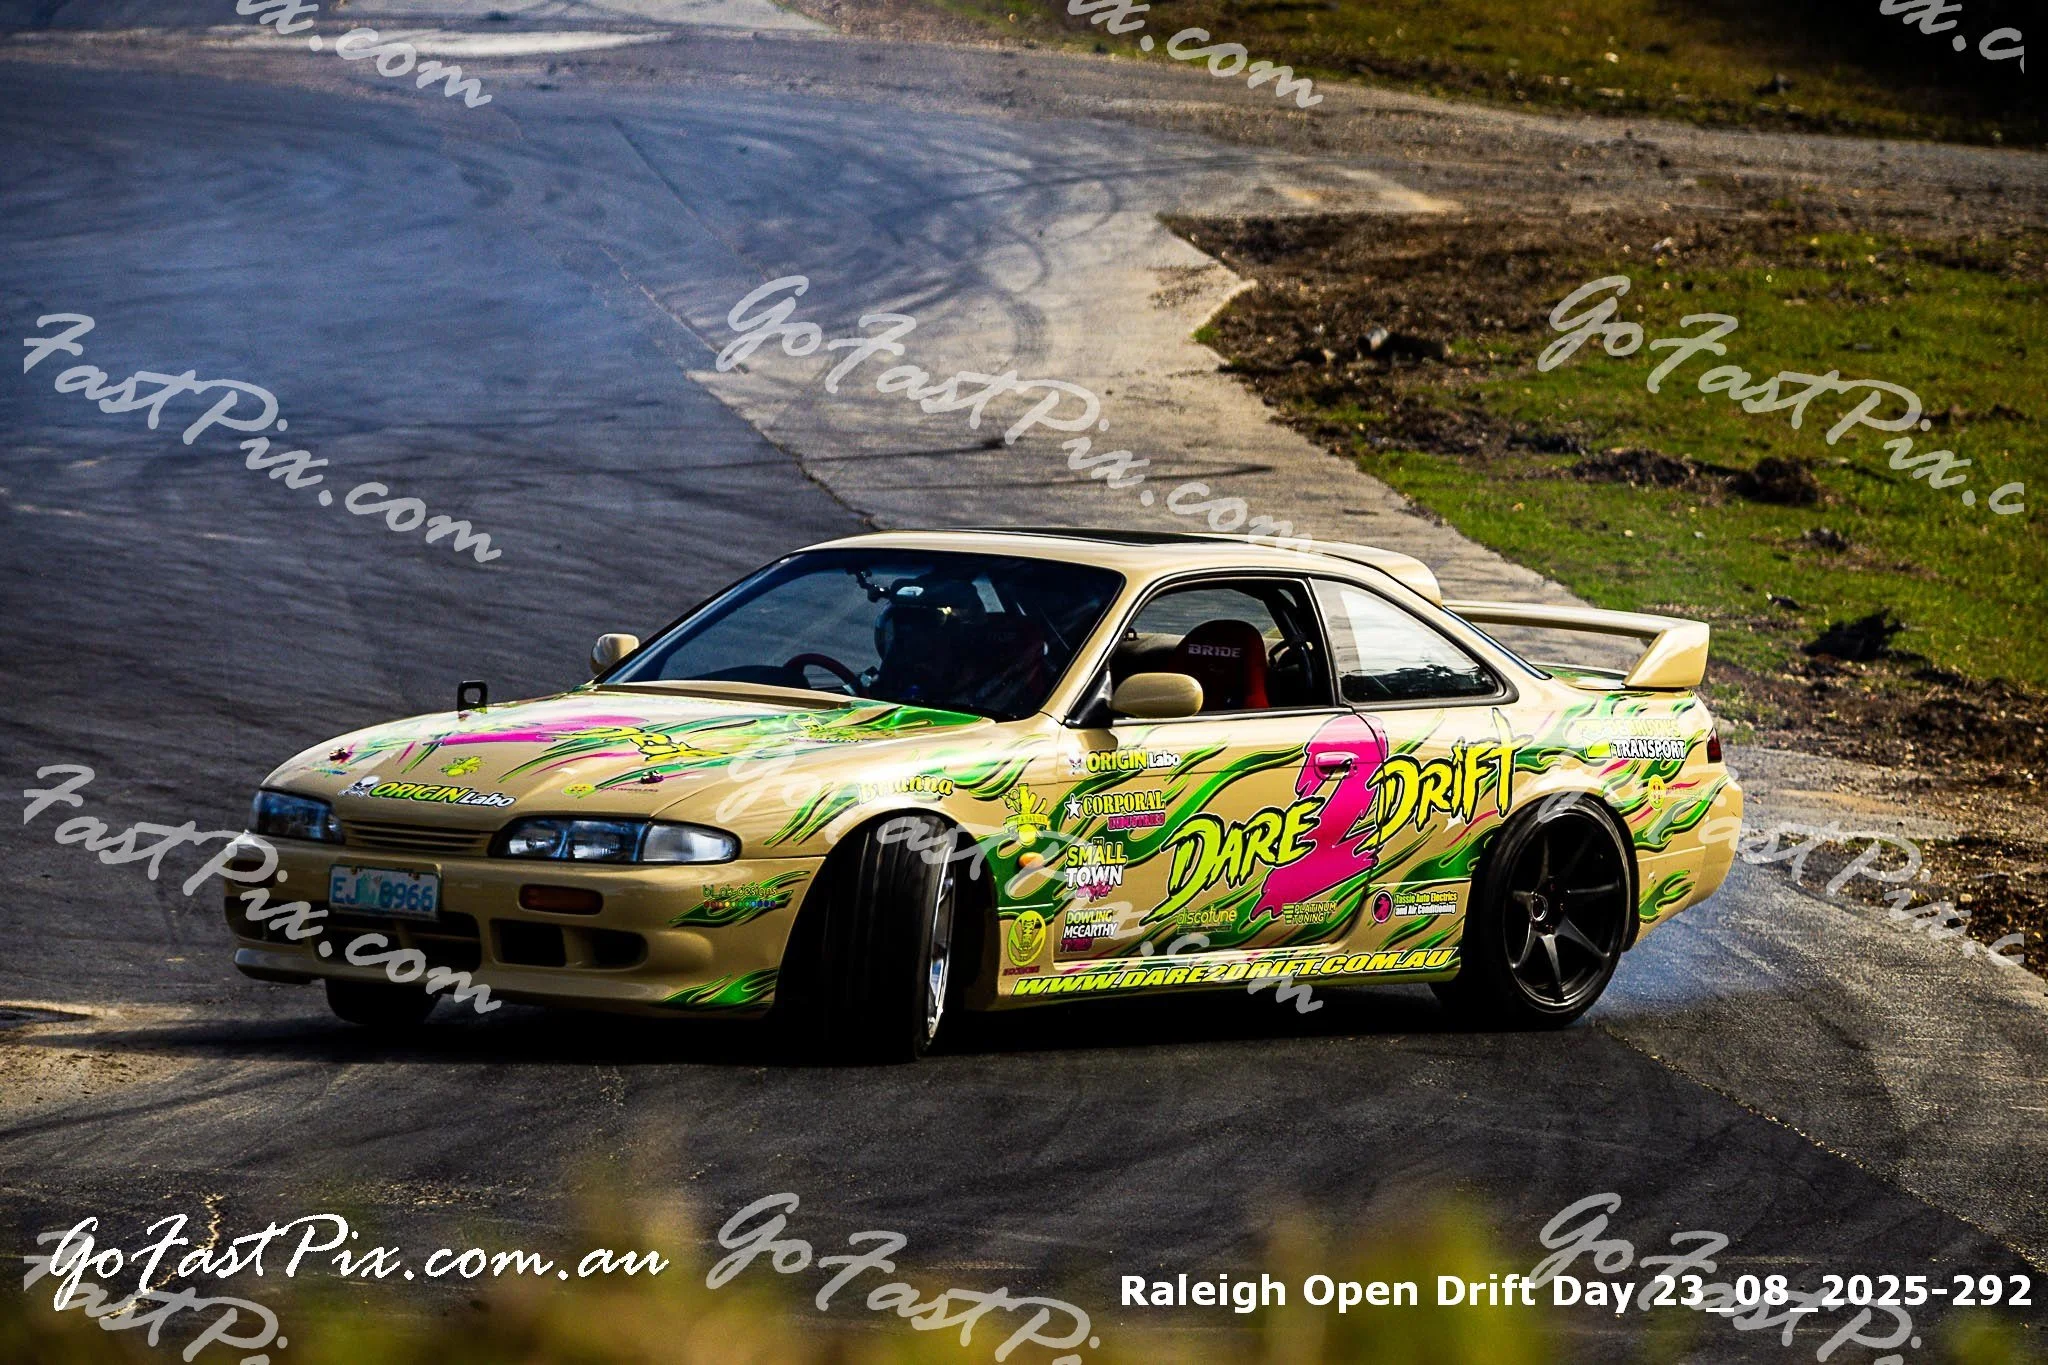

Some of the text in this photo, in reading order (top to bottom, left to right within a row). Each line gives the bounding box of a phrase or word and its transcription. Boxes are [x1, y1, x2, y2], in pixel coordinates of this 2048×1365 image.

[1187, 643, 1241, 659] BRIDE
[1614, 738, 1687, 760] TRANSPORT
[1086, 750, 1182, 773] ORIGIN Labo
[370, 782, 516, 808] ORIGIN Labo
[1082, 790, 1166, 816] CORPORAL
[1139, 797, 1326, 926] DARE
[1251, 712, 1390, 921] 2
[1065, 842, 1127, 867] SMALL
[1065, 863, 1124, 888] TOWN
[378, 880, 434, 912] 8966
[1293, 901, 1337, 914] PLATINUM
[1415, 892, 1430, 903] Auto
[1430, 890, 1458, 903] Electrics
[1065, 909, 1114, 925] DOWLING
[1175, 905, 1238, 925] discotune
[1291, 911, 1325, 924] TUNING
[1011, 947, 1458, 996] WWW.DARE2DRIFT.COM.AU
